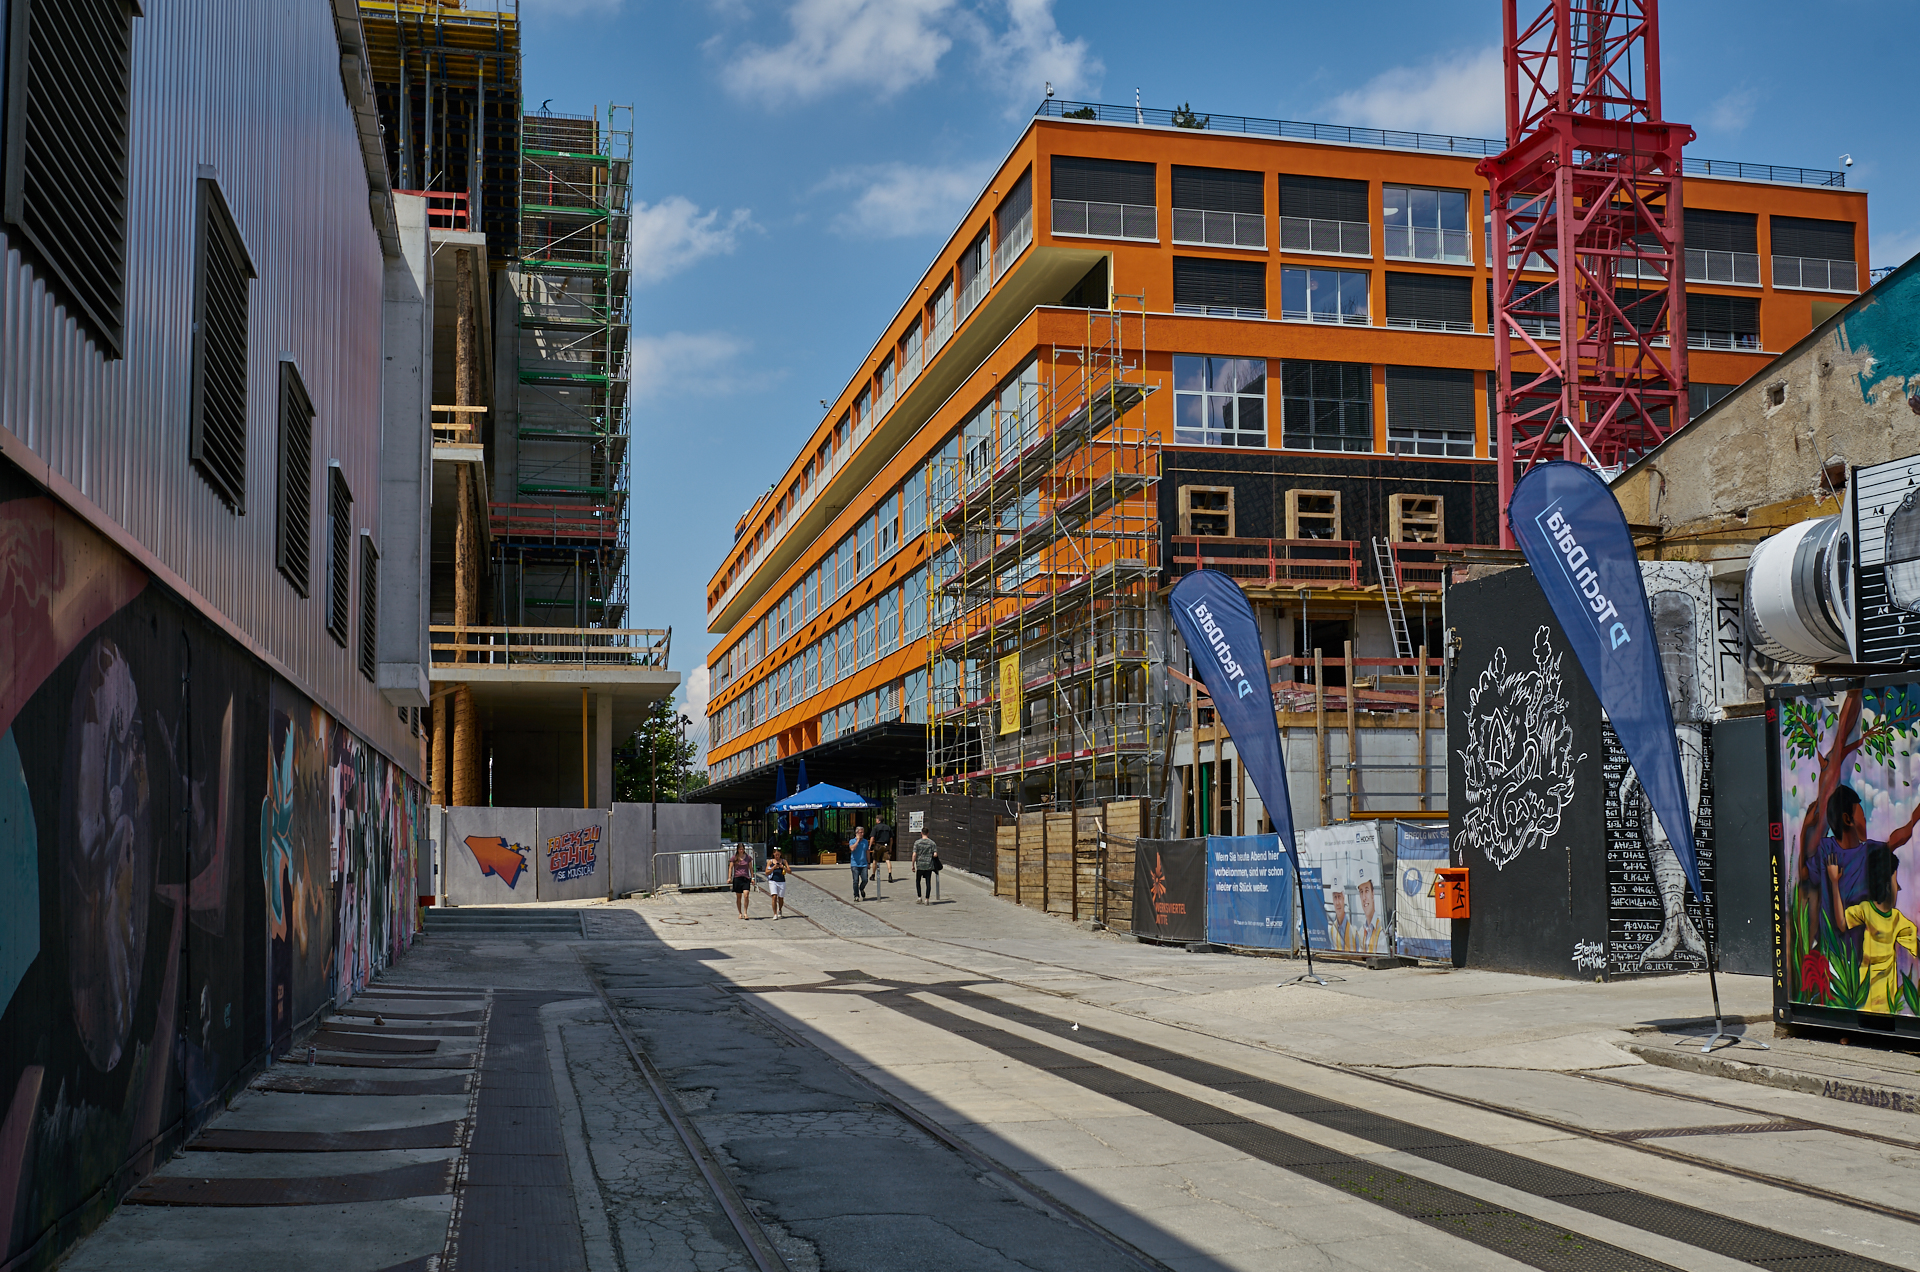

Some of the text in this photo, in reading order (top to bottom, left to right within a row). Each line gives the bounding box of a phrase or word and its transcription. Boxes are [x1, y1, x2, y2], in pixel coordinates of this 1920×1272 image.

[1878, 607, 1884, 615] A
[1898, 626, 1905, 635] D
[547, 825, 601, 855] FACK JU
[1215, 852, 1228, 861] Wenn
[1237, 852, 1250, 861] heute
[1250, 851, 1267, 861] Abend
[1268, 851, 1280, 860] hier
[558, 870, 566, 879] SE
[1249, 867, 1259, 876] sind
[1259, 867, 1267, 876] wir
[1268, 866, 1283, 876] schon
[1216, 882, 1232, 891] wieder
[1239, 882, 1252, 892] Stück
[1772, 855, 1781, 945] ALEXANDRE
